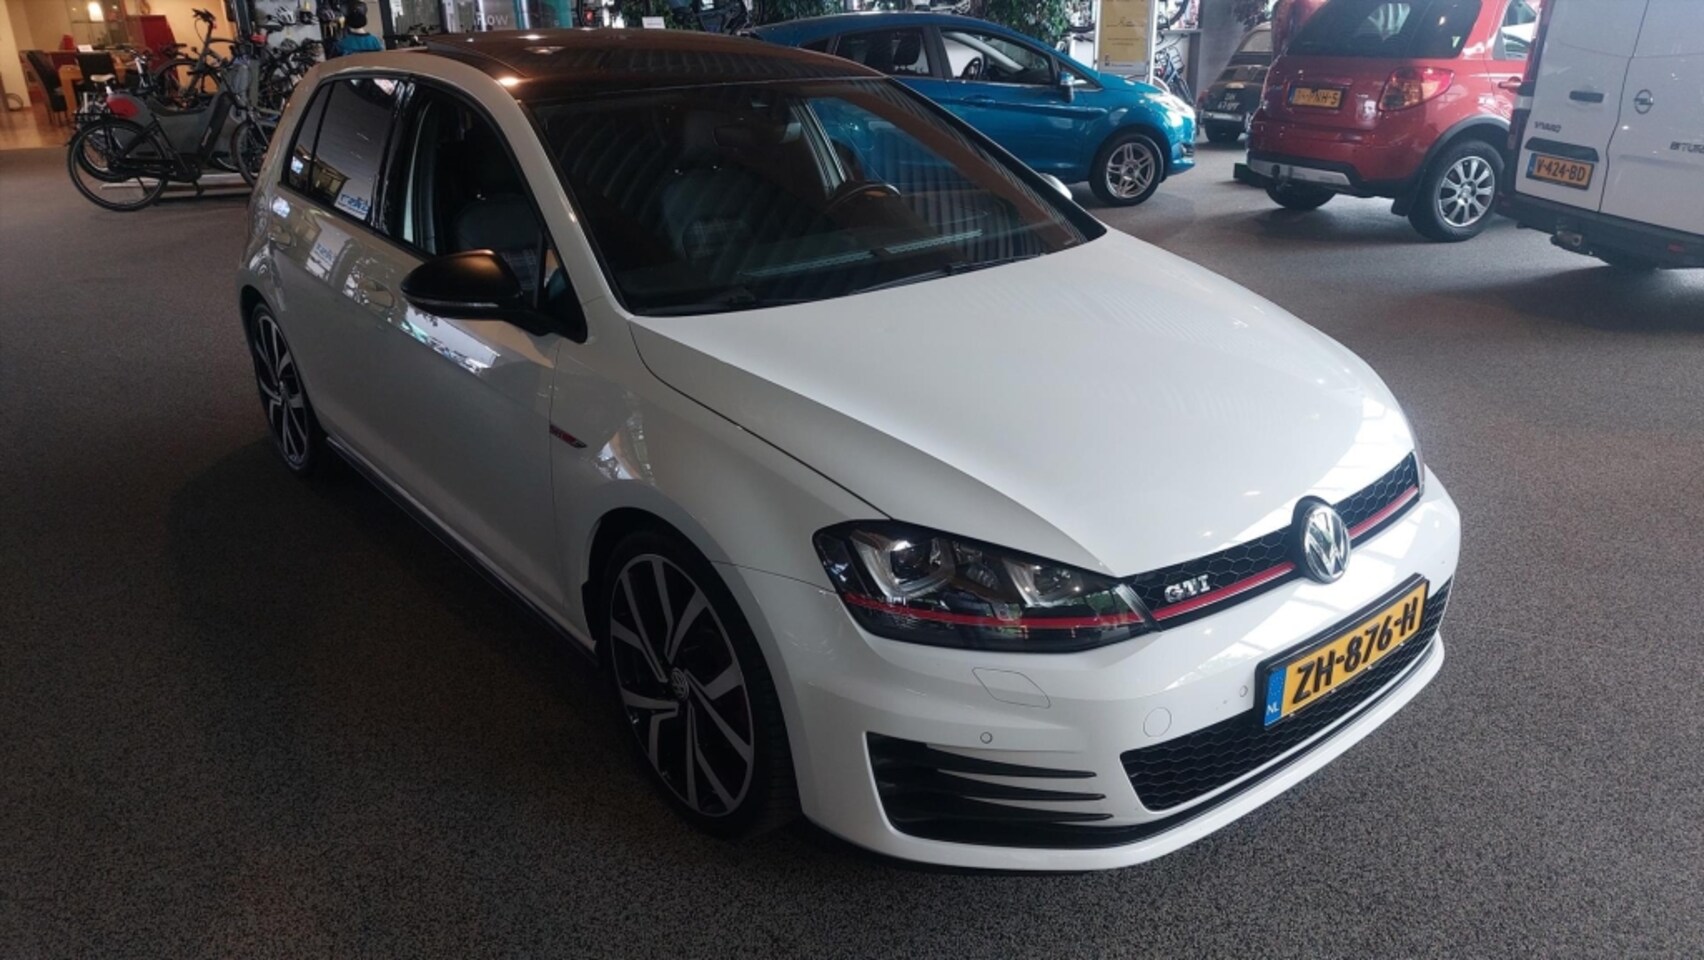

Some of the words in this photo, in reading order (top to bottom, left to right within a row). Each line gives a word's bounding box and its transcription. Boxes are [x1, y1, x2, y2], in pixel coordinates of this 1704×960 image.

[1536, 158, 1587, 182] V-424-BD
[1164, 574, 1211, 603] GTI
[1292, 596, 1418, 704] ZH-876-H
[1266, 702, 1280, 714] NL
